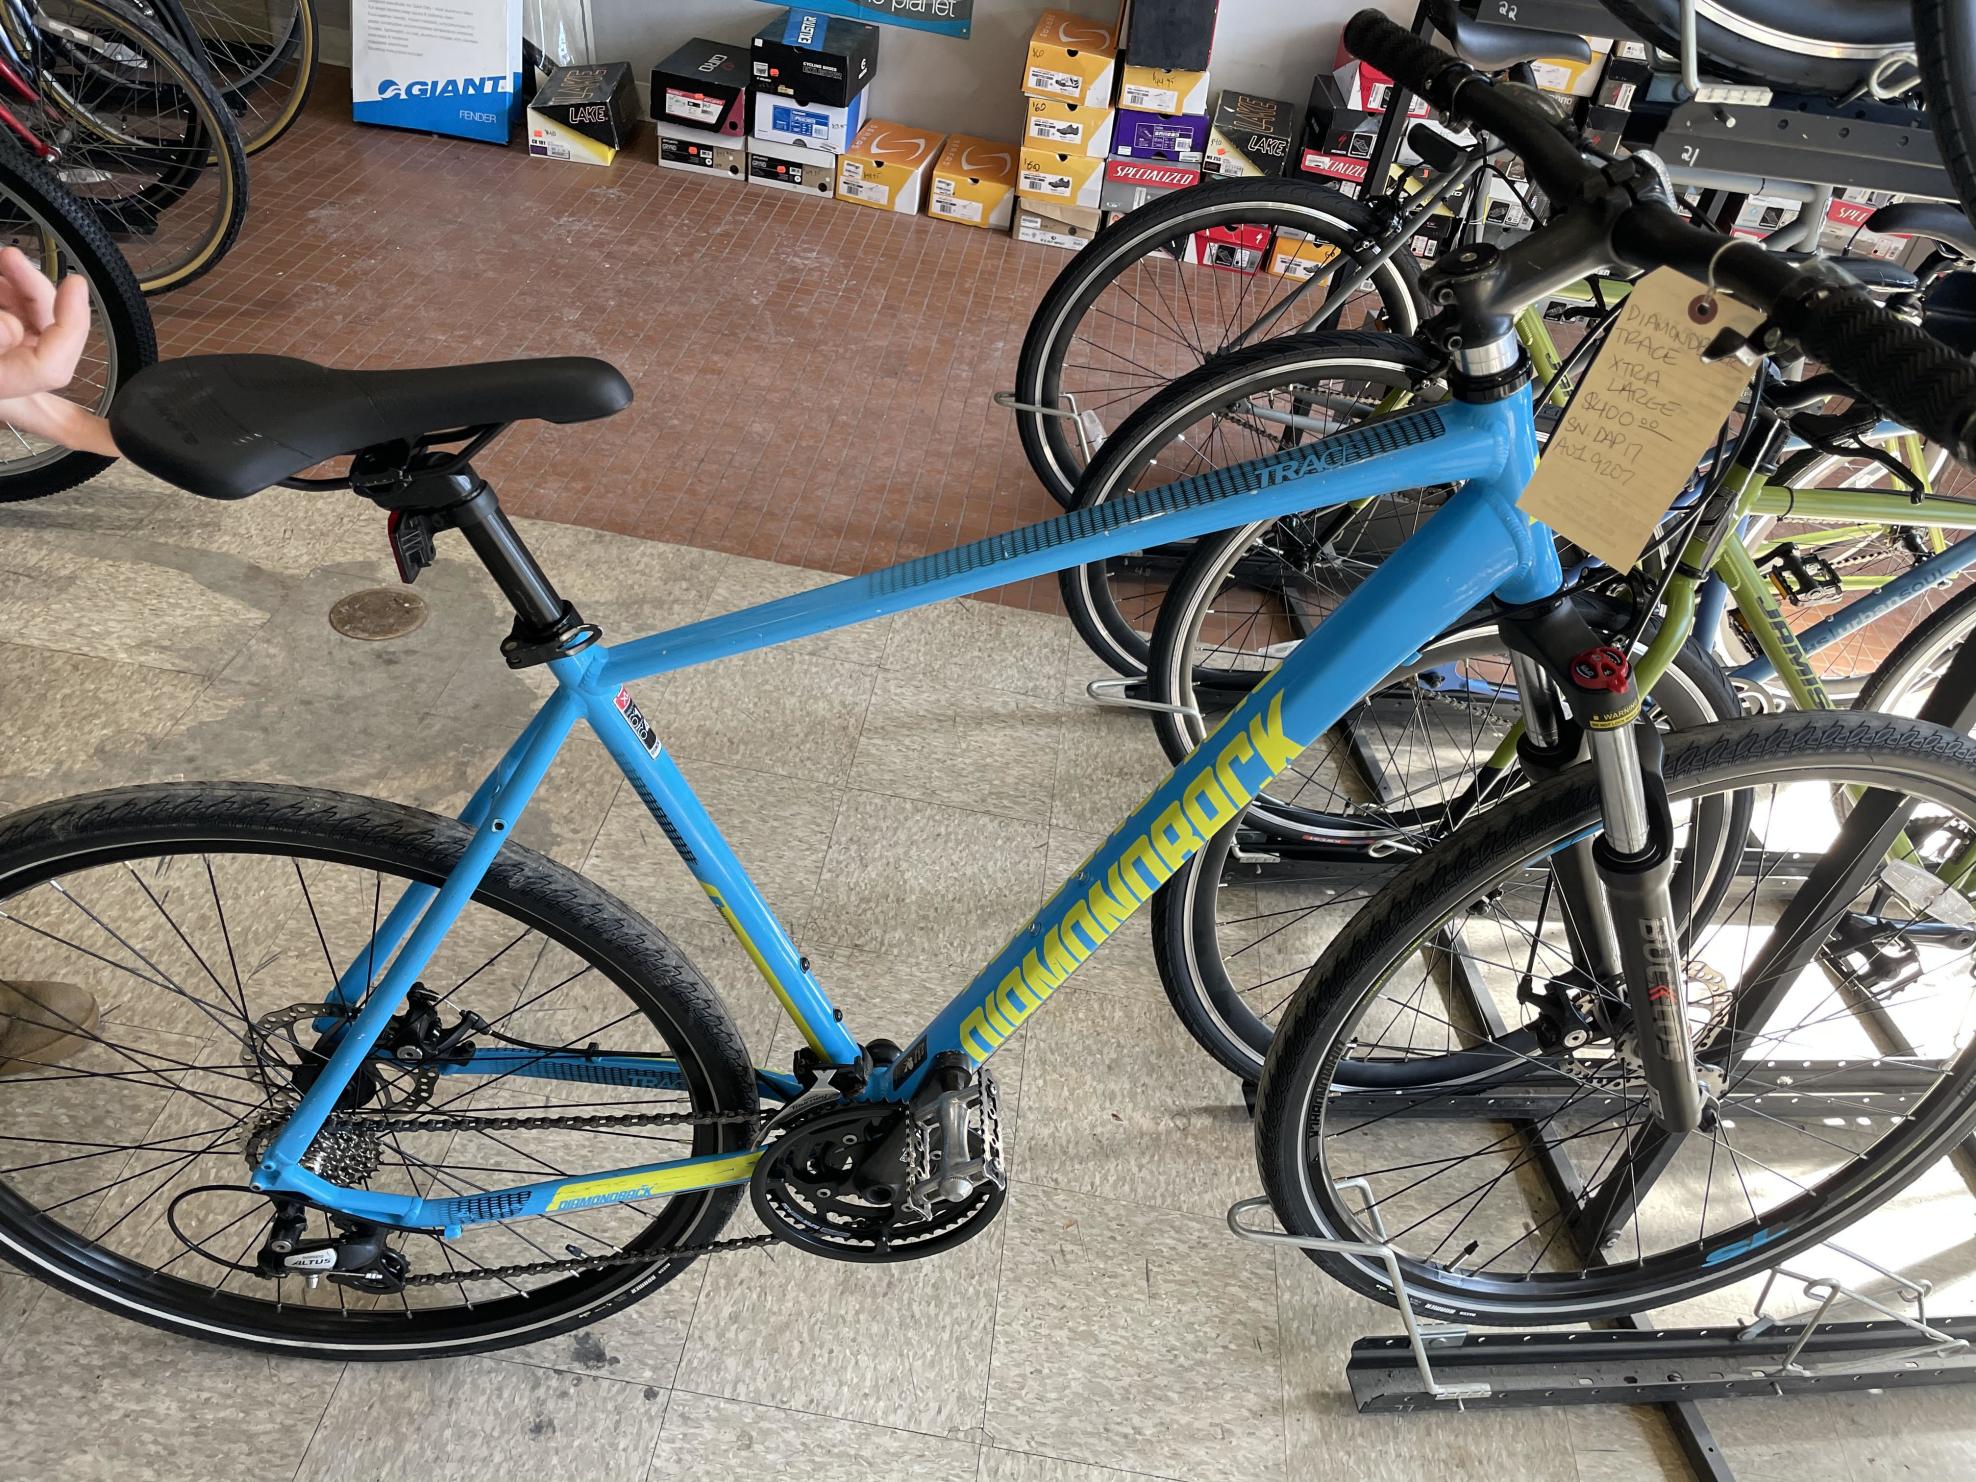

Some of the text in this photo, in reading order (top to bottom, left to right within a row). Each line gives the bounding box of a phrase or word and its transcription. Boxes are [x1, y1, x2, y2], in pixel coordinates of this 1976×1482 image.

[798, 16, 816, 44] EXUSTAR
[404, 76, 508, 98] GIANT
[459, 110, 497, 123] FENDER
[569, 106, 606, 124] LAKE
[1233, 95, 1277, 133] LAKE
[1248, 135, 1286, 157] LAKE
[1114, 165, 1194, 185] SPECIALIZED
[1616, 327, 1681, 365] TRACE
[1608, 353, 1659, 388] XTRA
[1608, 378, 1682, 416] LARGE
[1757, 596, 1831, 710] JAMIS
[959, 689, 1304, 1063] DIAMONDBACK
[629, 1074, 687, 1090] TRAC
[558, 1185, 655, 1209] DIAMONDBACK
